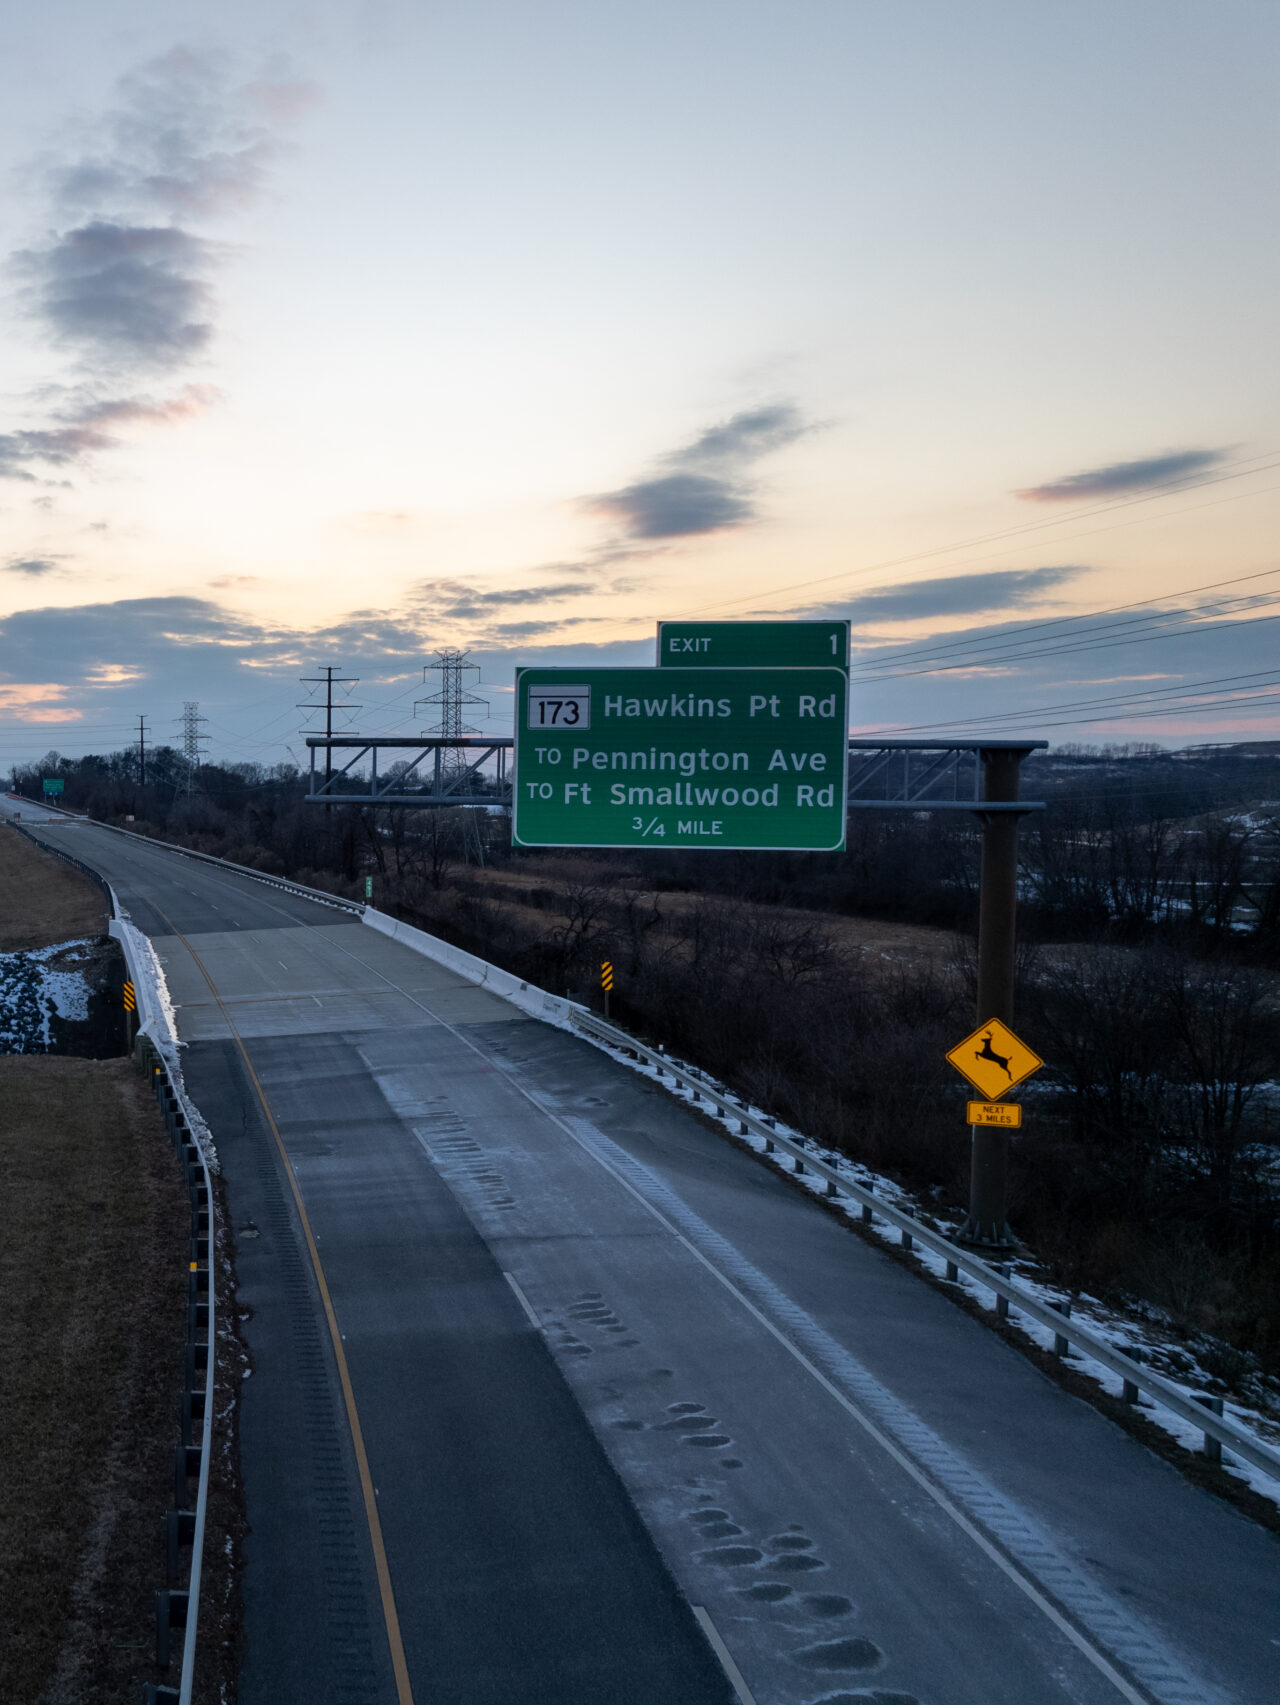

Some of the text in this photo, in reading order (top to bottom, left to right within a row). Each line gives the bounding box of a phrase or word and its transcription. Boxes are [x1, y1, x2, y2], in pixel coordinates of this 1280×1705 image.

[669, 634, 837, 655] EXIT 1
[538, 700, 580, 725] 173
[604, 693, 836, 718] Hawkins Pt Rd
[534, 747, 827, 776] TO Pennington Ave
[526, 782, 834, 807] TO Ft Smallwood Rd
[677, 820, 723, 835] MILE
[983, 1106, 1005, 1114] NEXT
[986, 1115, 1012, 1123] MILES
